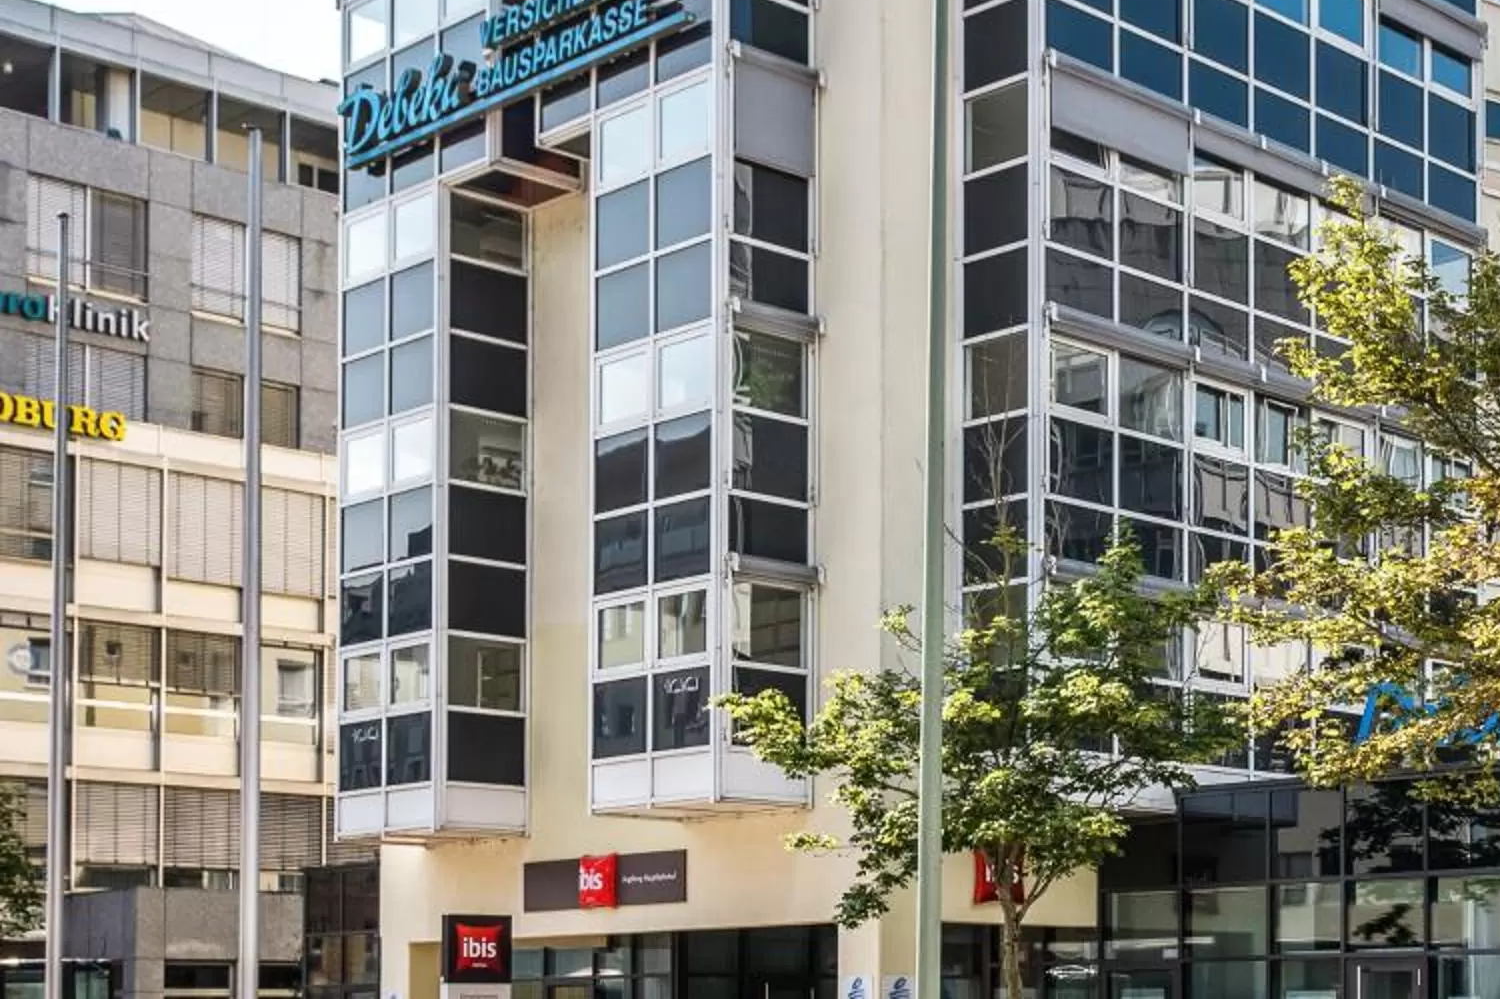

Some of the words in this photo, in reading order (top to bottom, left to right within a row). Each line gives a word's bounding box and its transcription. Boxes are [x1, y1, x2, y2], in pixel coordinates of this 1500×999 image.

[337, 52, 462, 154] Debeka
[0, 291, 150, 342] roklinik
[463, 936, 497, 959] ibis
